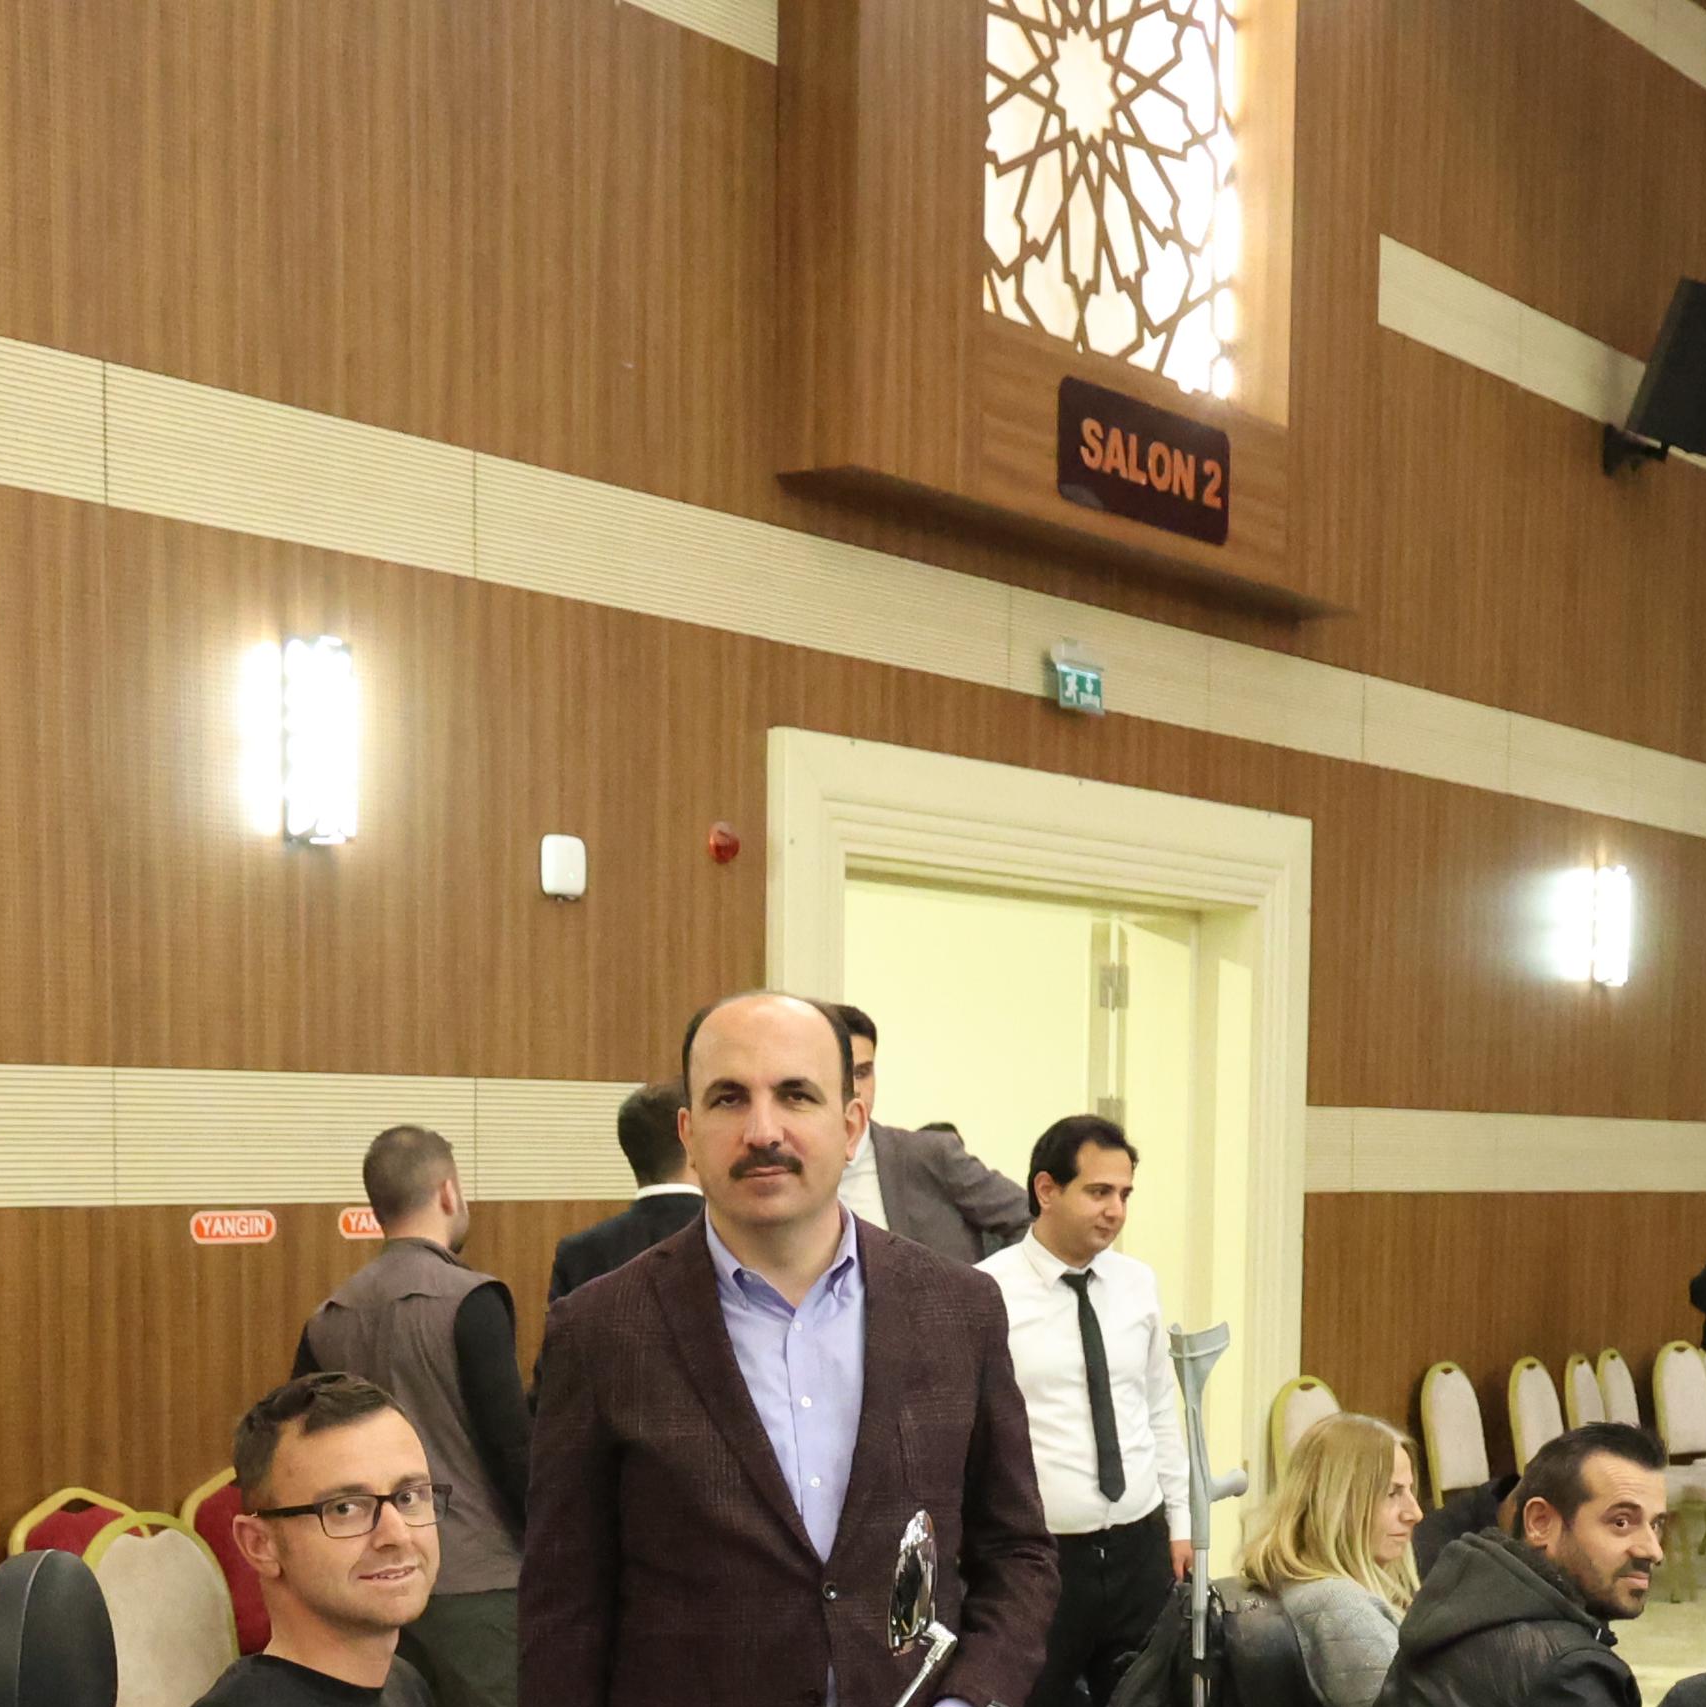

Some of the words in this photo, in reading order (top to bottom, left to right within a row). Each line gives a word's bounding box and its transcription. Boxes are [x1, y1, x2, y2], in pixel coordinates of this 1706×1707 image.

[1080, 417, 1196, 501] SALON
[1202, 460, 1223, 509] 2
[199, 1215, 268, 1237] YANGIN
[346, 1212, 384, 1232] YAN
